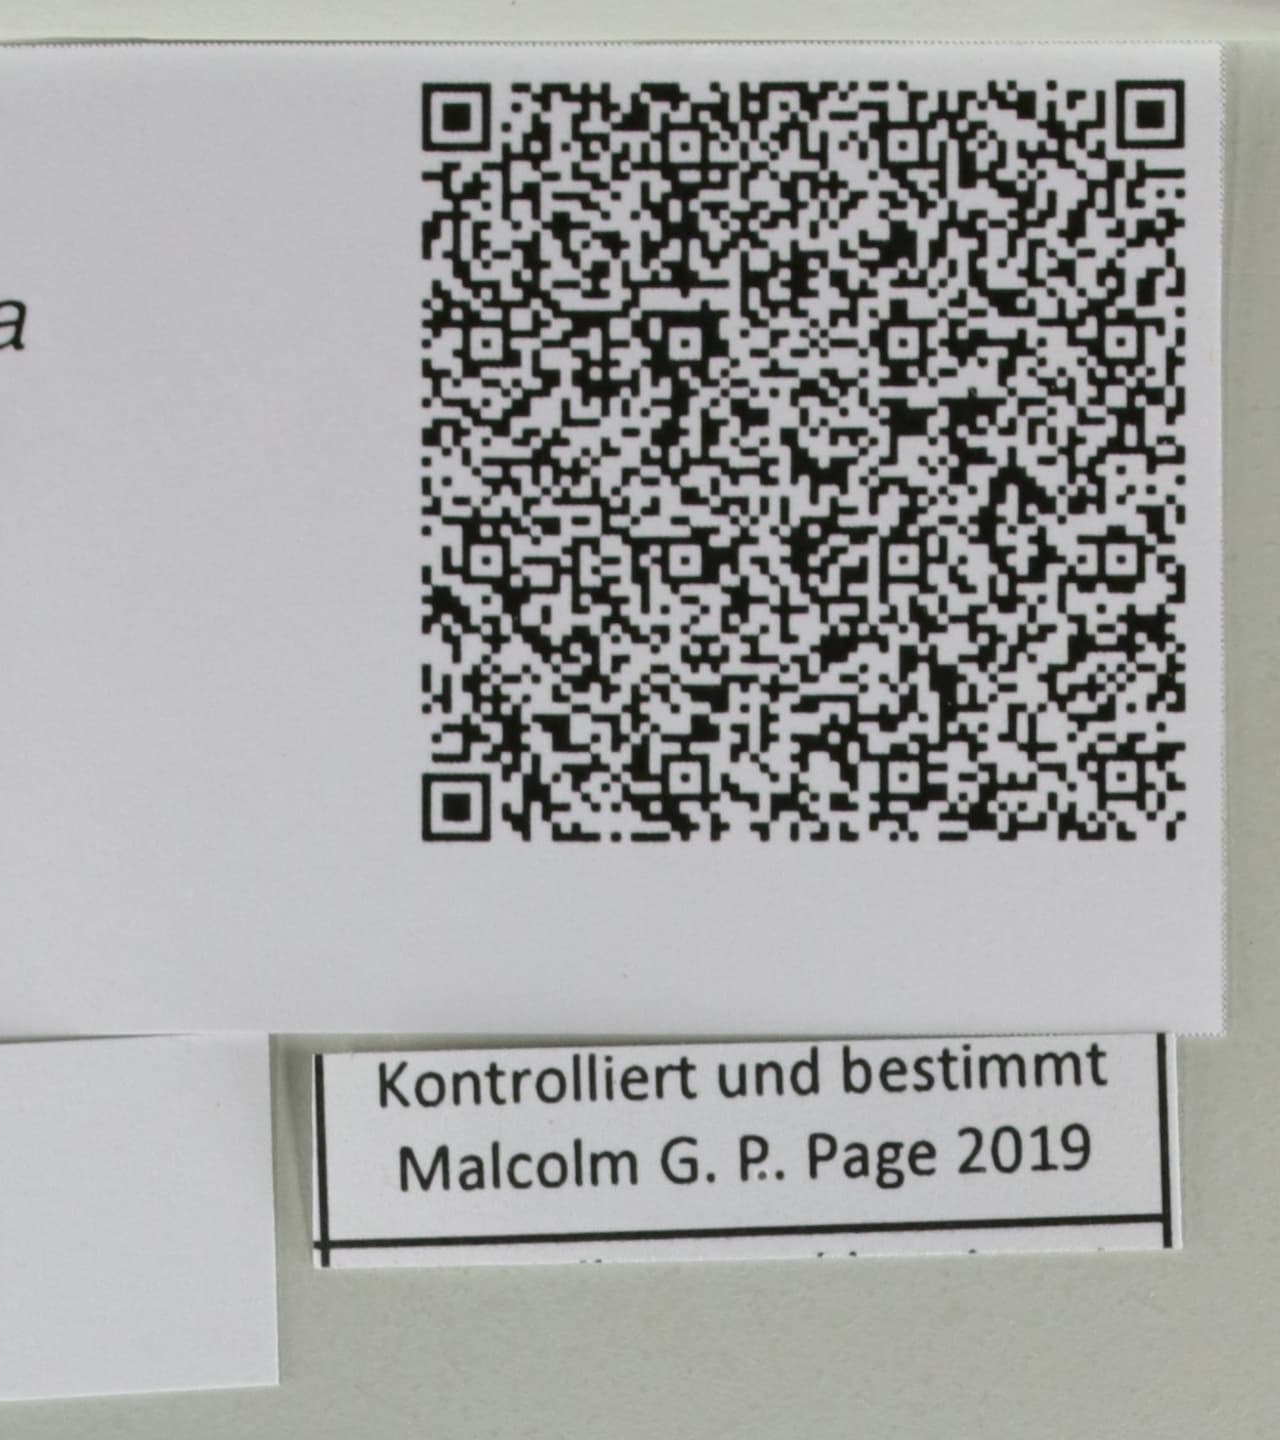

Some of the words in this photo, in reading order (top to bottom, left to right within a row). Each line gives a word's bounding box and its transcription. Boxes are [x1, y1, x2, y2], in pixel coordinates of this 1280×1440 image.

[376, 1054, 699, 1110] Kontrolliert
[716, 1044, 821, 1100] und
[840, 1038, 1110, 1093] bestimmt
[398, 1136, 640, 1194] Malcolm
[659, 1134, 717, 1186] G.
[738, 1133, 786, 1183] P.
[807, 1131, 938, 1184] Page
[956, 1121, 1092, 1176] 2019
